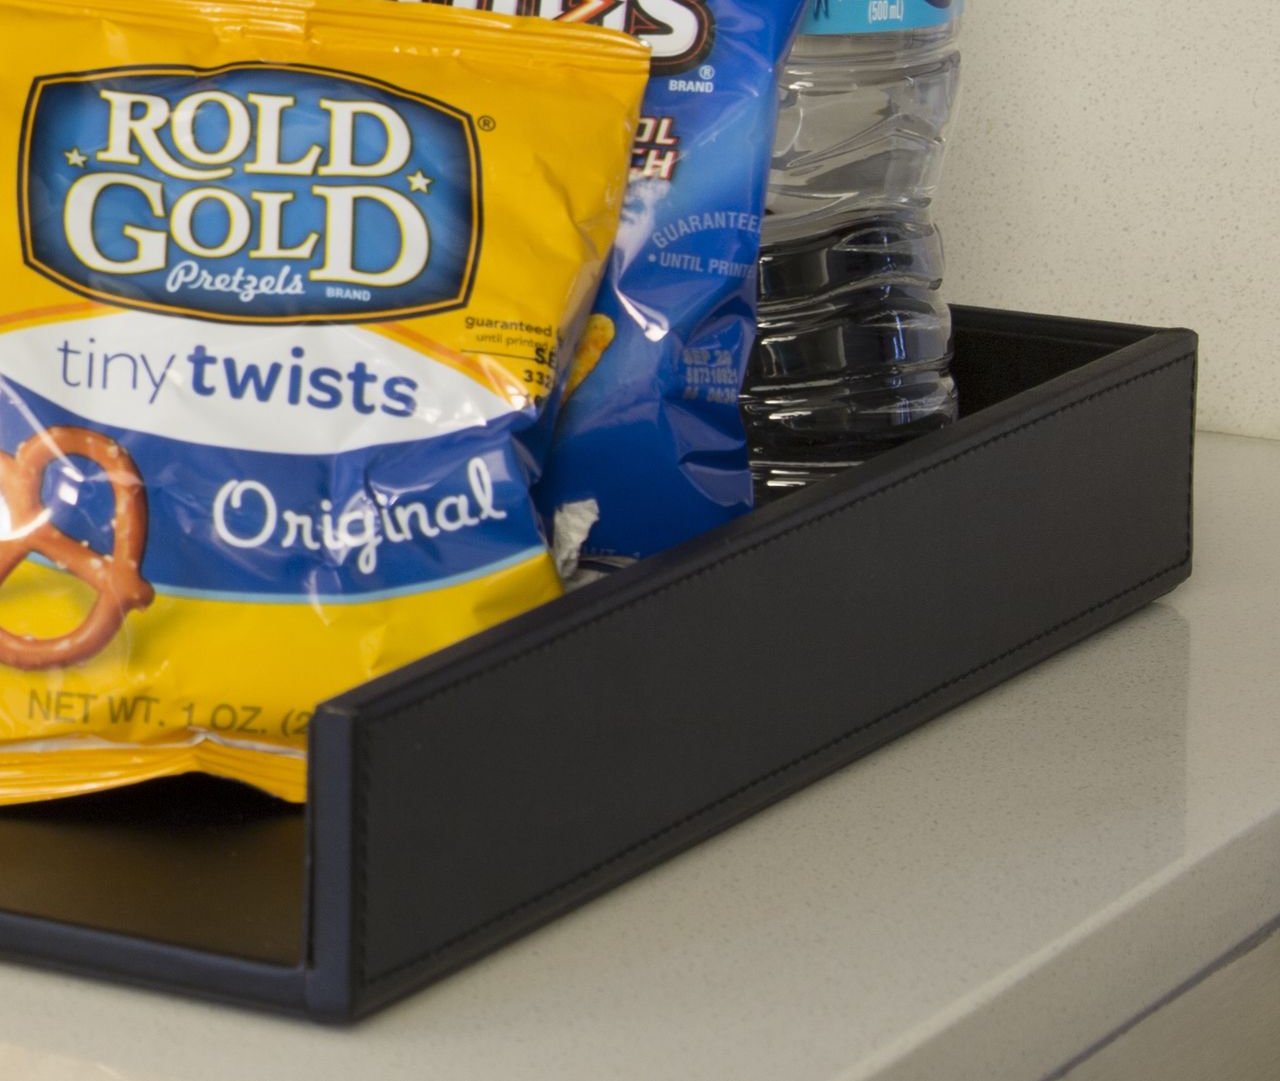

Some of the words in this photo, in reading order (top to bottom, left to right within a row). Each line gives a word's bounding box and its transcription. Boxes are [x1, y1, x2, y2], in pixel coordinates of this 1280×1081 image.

[868, 0, 889, 24] (500
[668, 79, 715, 94] BRAND
[95, 89, 412, 181] ROLD
[62, 172, 431, 288] GOLD
[660, 251, 704, 274] UNTIL
[166, 259, 306, 302] Pretzels
[325, 286, 371, 302] BRAND
[465, 315, 553, 337] guaranteed
[475, 333, 503, 344] until
[57, 337, 176, 405] tiny
[187, 344, 418, 418] twists
[212, 456, 508, 575] Original
[27, 688, 98, 725] NET
[108, 695, 165, 728] WT.
[182, 702, 195, 727] 1
[209, 703, 268, 735] OZ.
